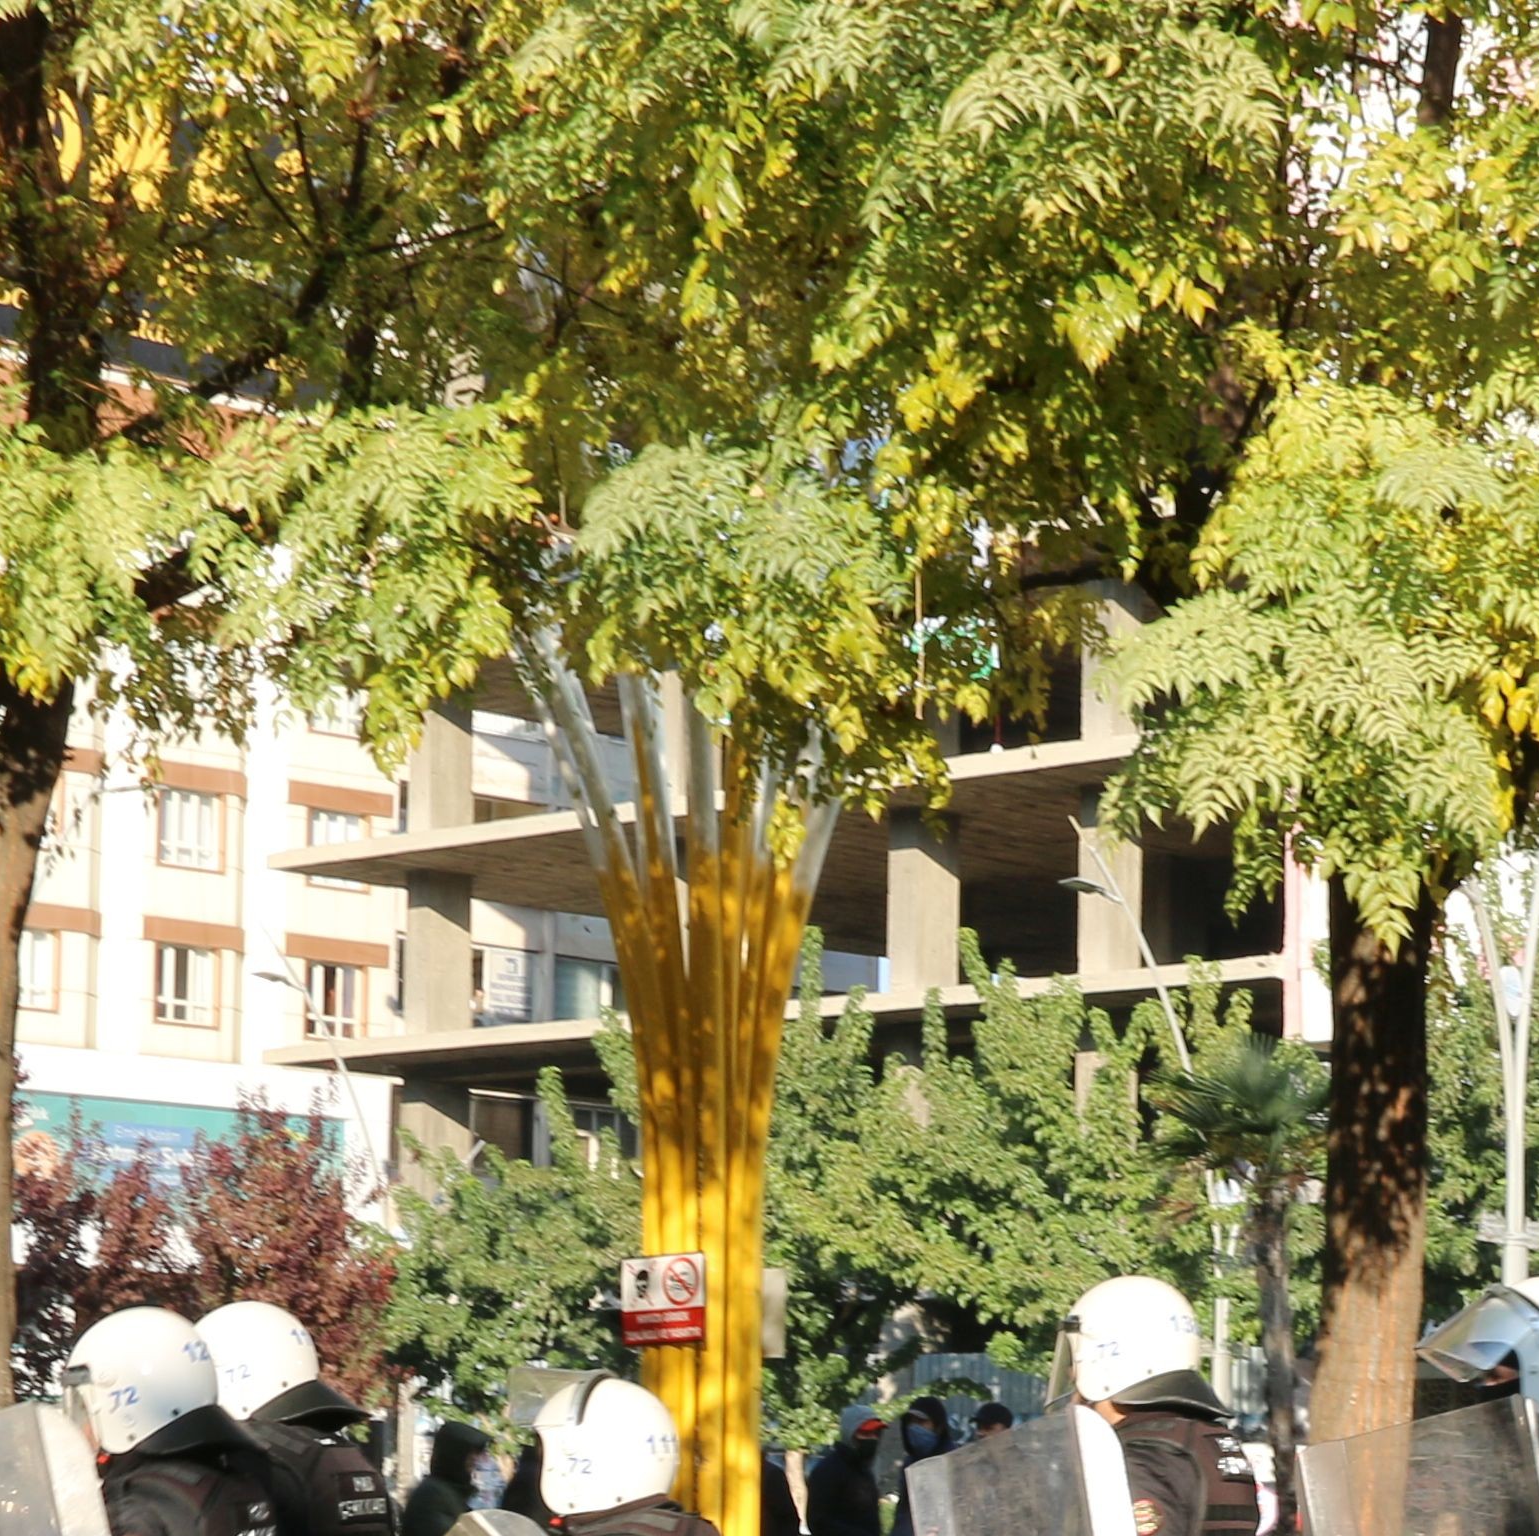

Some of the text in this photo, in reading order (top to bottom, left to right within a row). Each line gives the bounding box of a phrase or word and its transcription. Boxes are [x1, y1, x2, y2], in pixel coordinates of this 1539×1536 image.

[225, 1364, 251, 1382] 72
[110, 1386, 140, 1413] 72
[567, 1457, 592, 1474] 72
